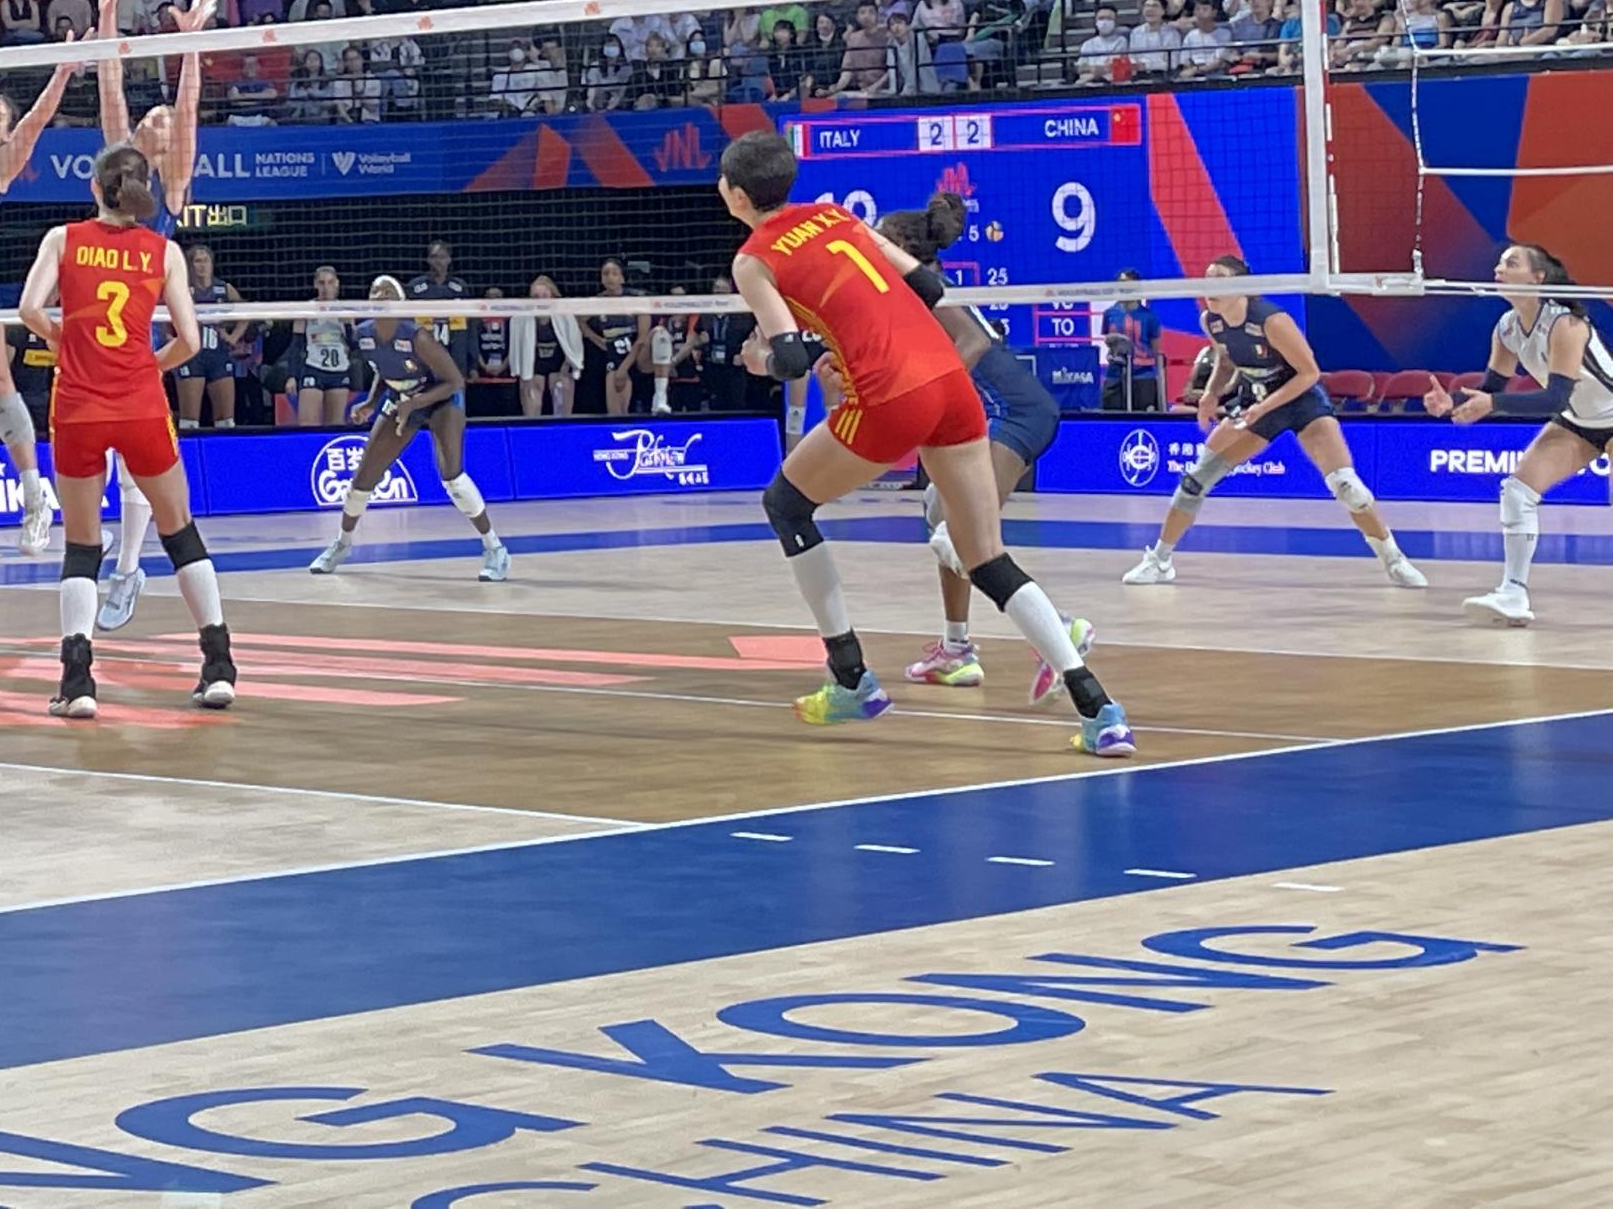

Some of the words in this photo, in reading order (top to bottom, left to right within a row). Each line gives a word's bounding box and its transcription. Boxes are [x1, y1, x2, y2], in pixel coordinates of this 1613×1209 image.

[819, 128, 861, 148] ITALY
[930, 123, 942, 146] 2
[967, 121, 980, 144] 2
[1043, 117, 1100, 138] CHINA
[255, 152, 315, 165] NATIONS
[358, 151, 411, 166] Volleyball
[358, 164, 395, 175] World
[255, 165, 308, 178] LEAGUE
[207, 203, 247, 227] 出口
[1051, 181, 1096, 253] 9
[771, 220, 824, 256] YUAN
[968, 224, 980, 242] 5
[76, 245, 119, 269] DIAO
[825, 239, 890, 294] 1
[987, 267, 1009, 286] 25
[95, 280, 130, 348] 3
[1051, 318, 1075, 336] TO
[320, 348, 340, 368] 20
[1430, 449, 1527, 474] PREMI
[463, 925, 1528, 1095] KONG
